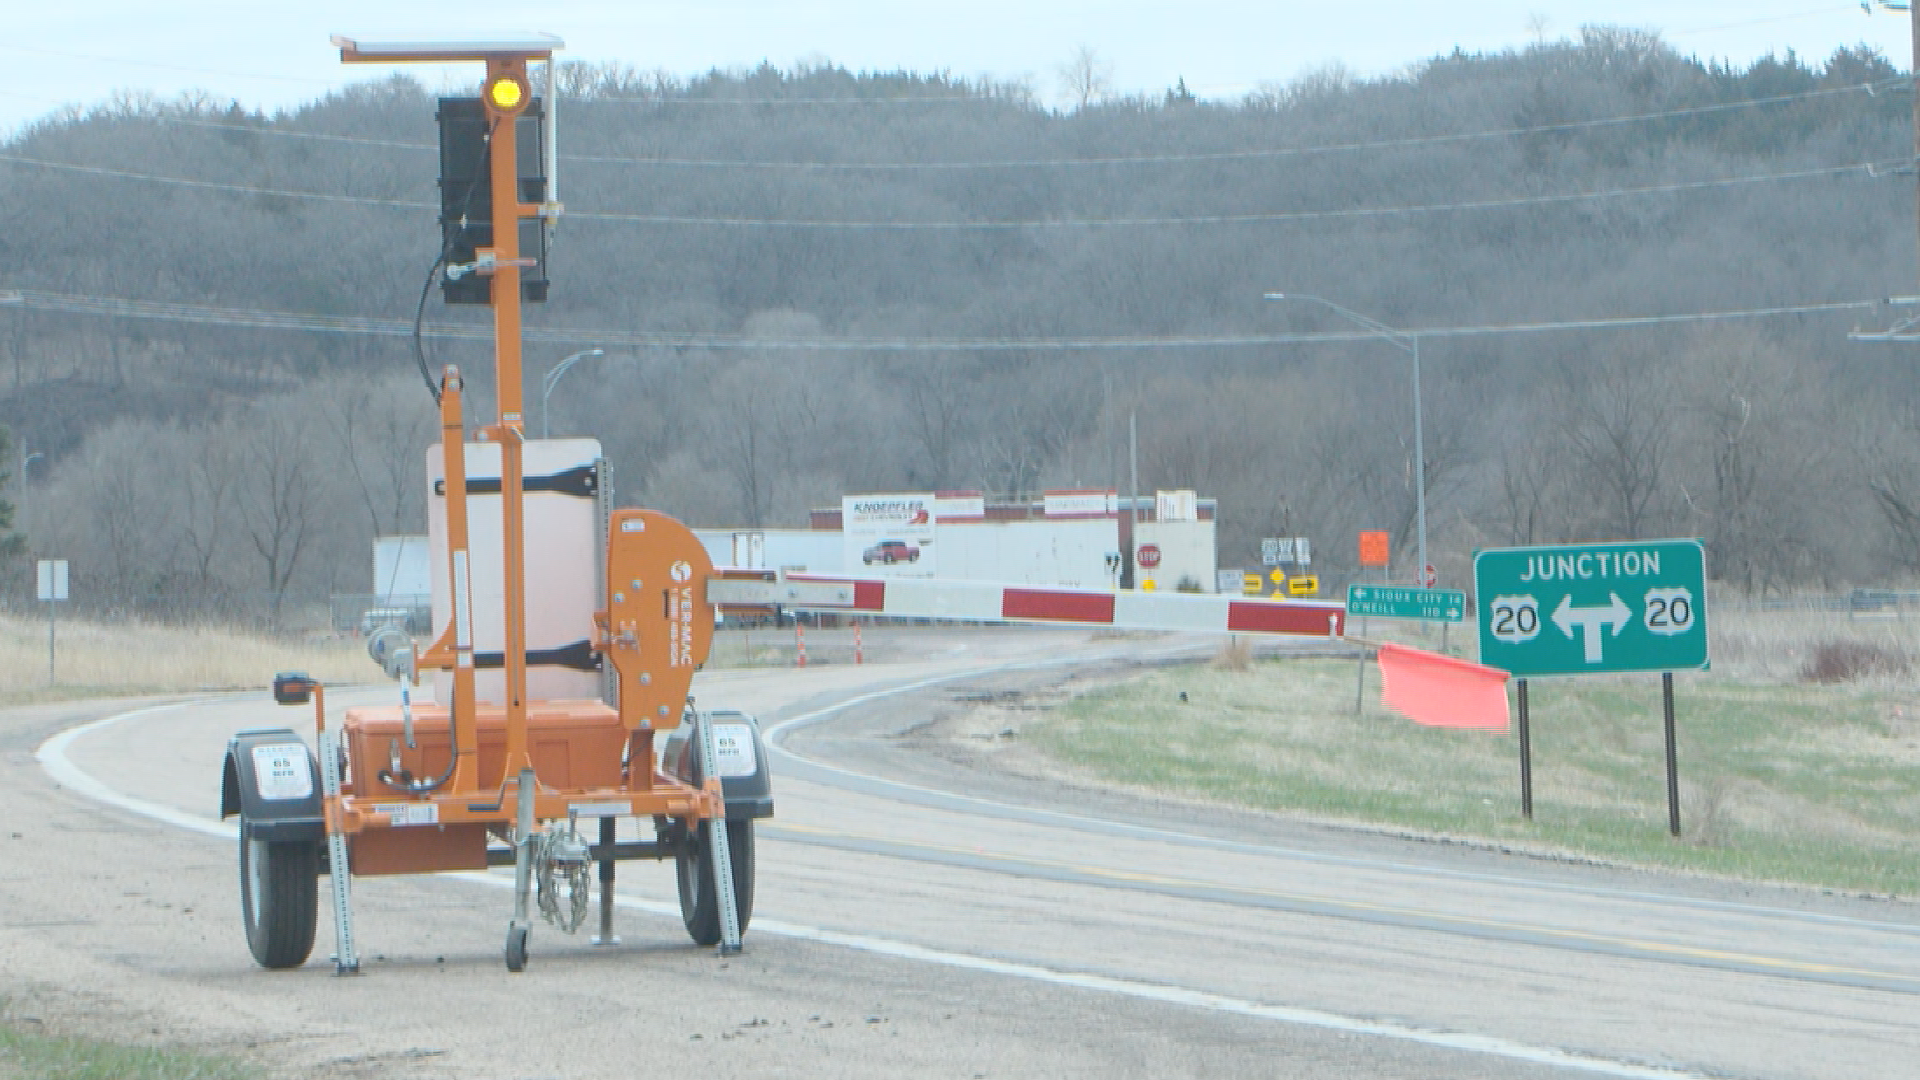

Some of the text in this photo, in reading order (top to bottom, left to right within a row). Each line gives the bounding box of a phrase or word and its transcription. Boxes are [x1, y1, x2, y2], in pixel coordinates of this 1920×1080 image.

[853, 501, 923, 513] KNOEPFLER
[1138, 550, 1161, 562] STOP
[1519, 551, 1661, 581] JUNCTION
[1373, 588, 1410, 602] SIOUX
[1416, 592, 1442, 603] CITY
[1352, 601, 1396, 614] O'NEILL
[1649, 597, 1690, 627] 20
[681, 586, 692, 665] VER-MAC
[1496, 606, 1537, 635] 20
